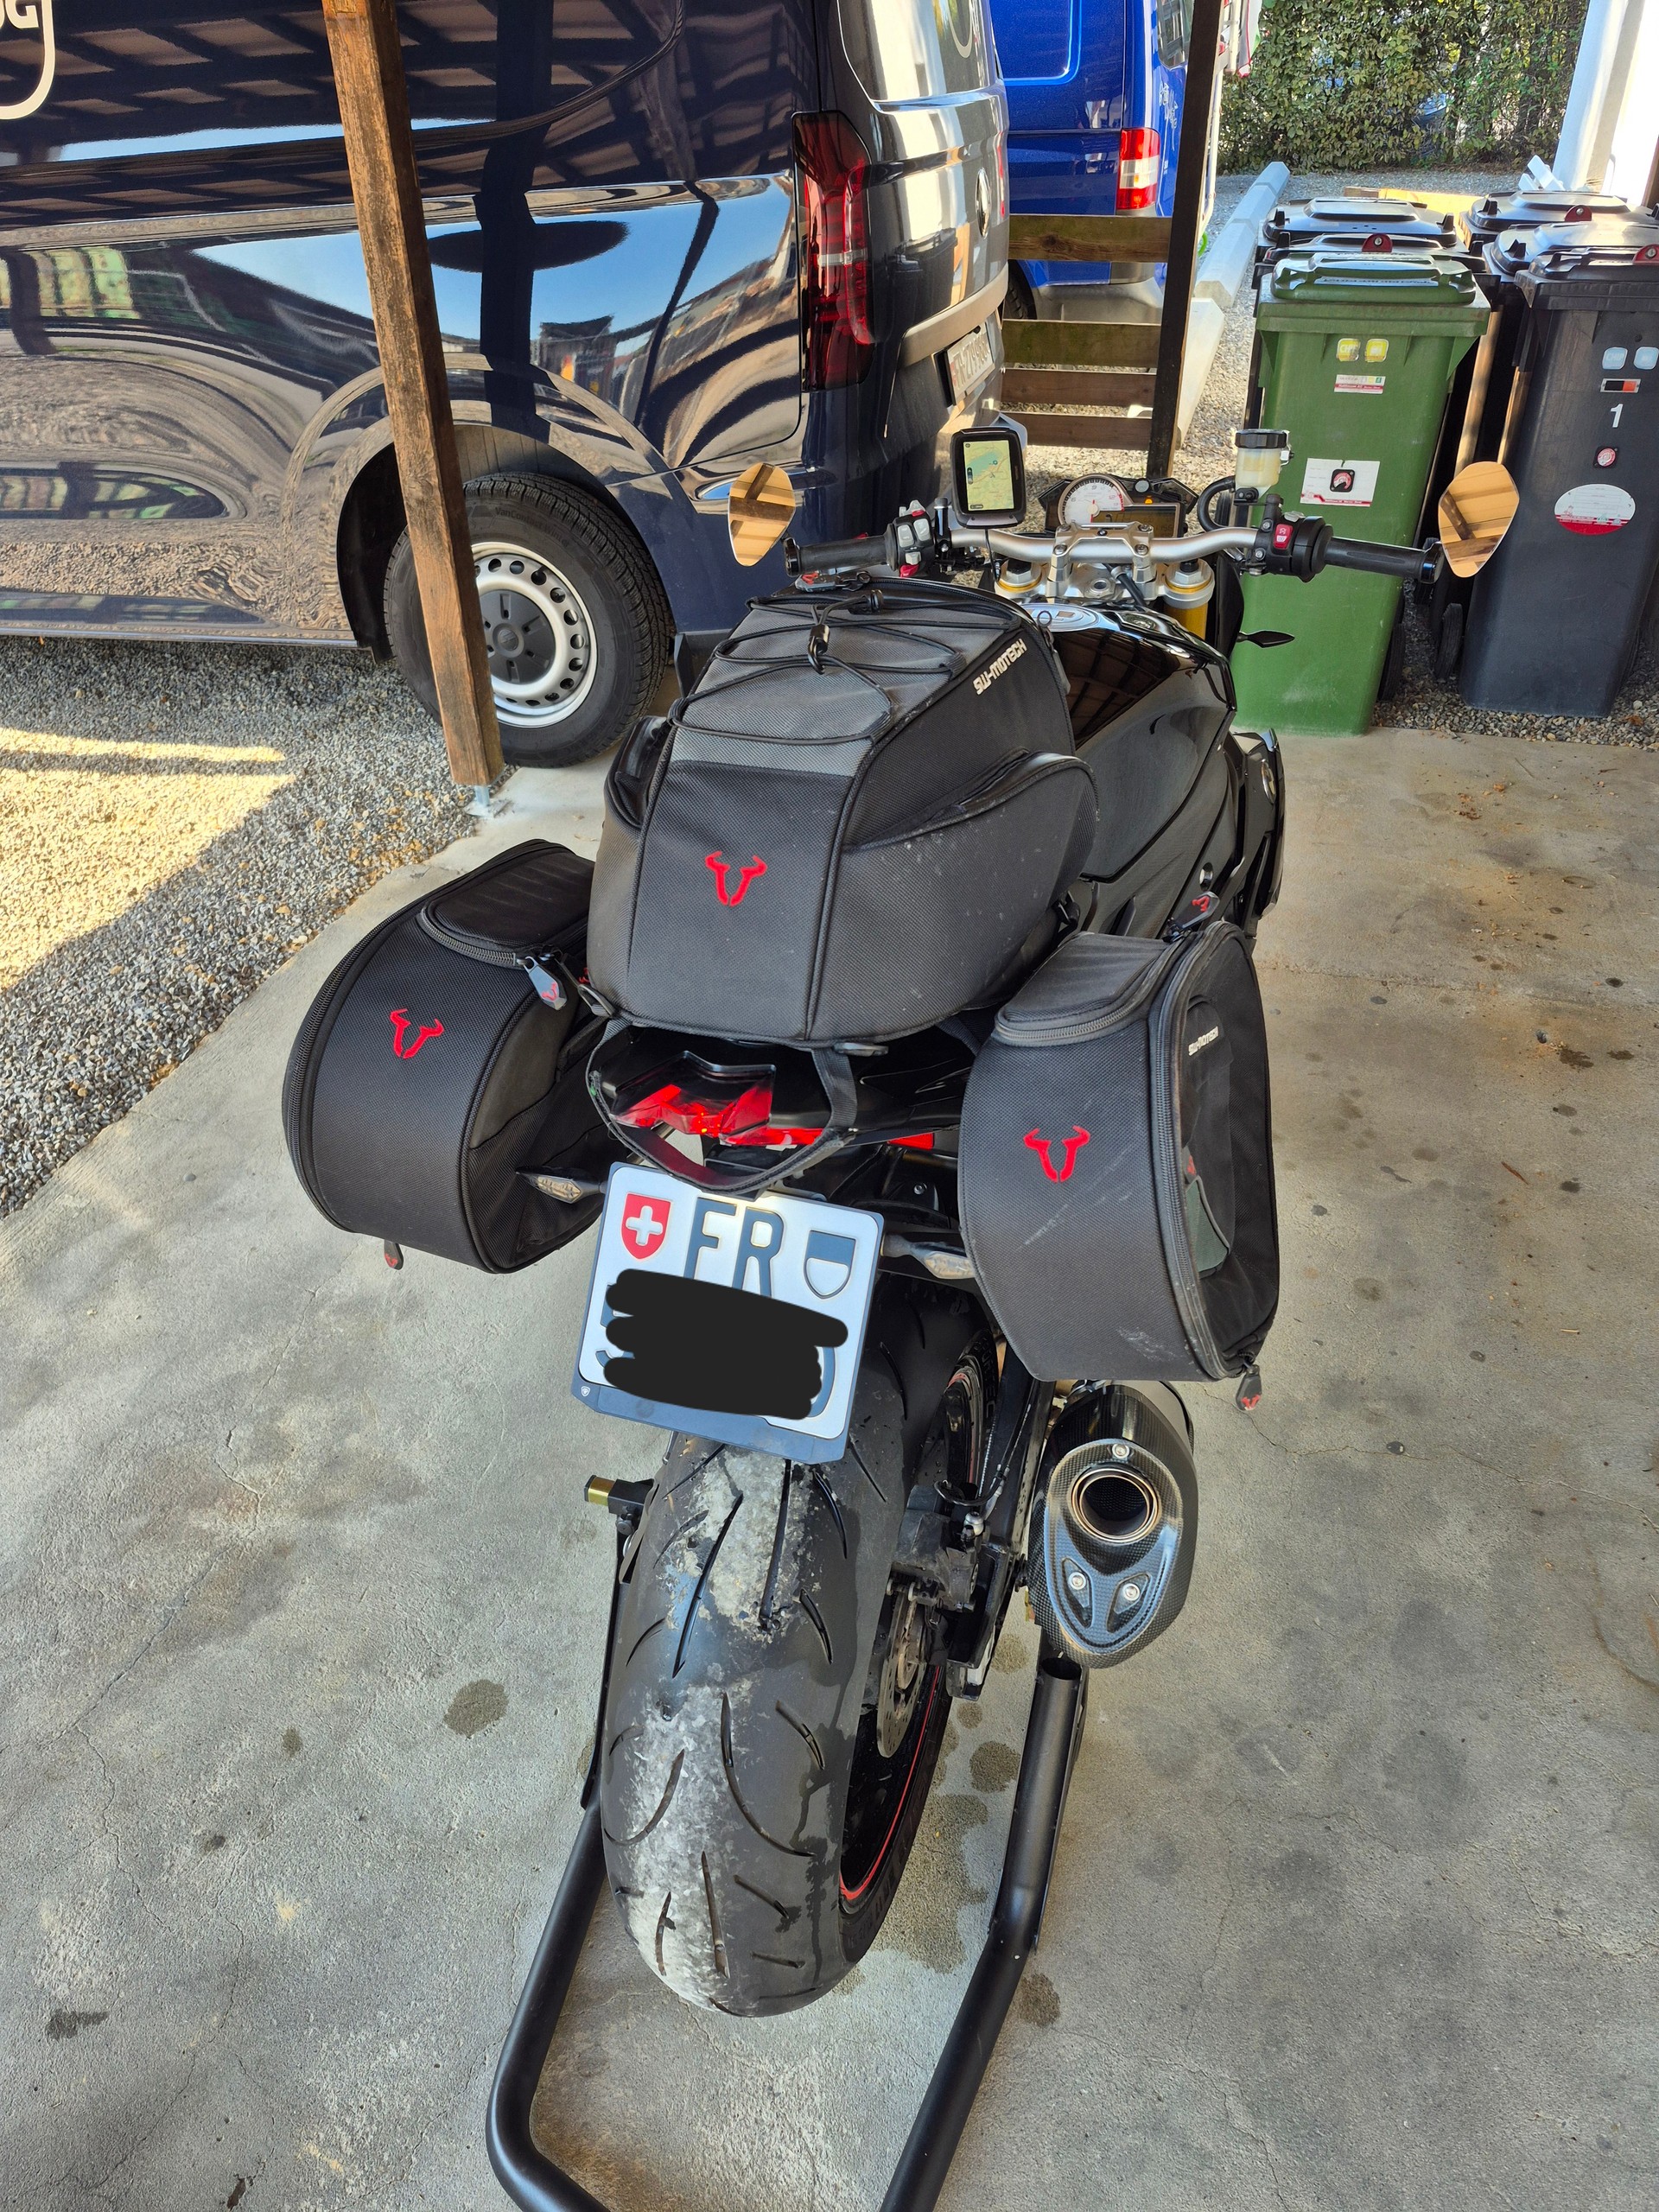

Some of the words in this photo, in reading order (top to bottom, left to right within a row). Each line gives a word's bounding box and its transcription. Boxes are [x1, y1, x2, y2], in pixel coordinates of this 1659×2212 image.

[1611, 404, 1624, 428] 1
[973, 639, 1027, 696] SW-MOTECH
[1188, 1026, 1219, 1056] SW-MOTECH
[683, 1196, 784, 1300] FR
